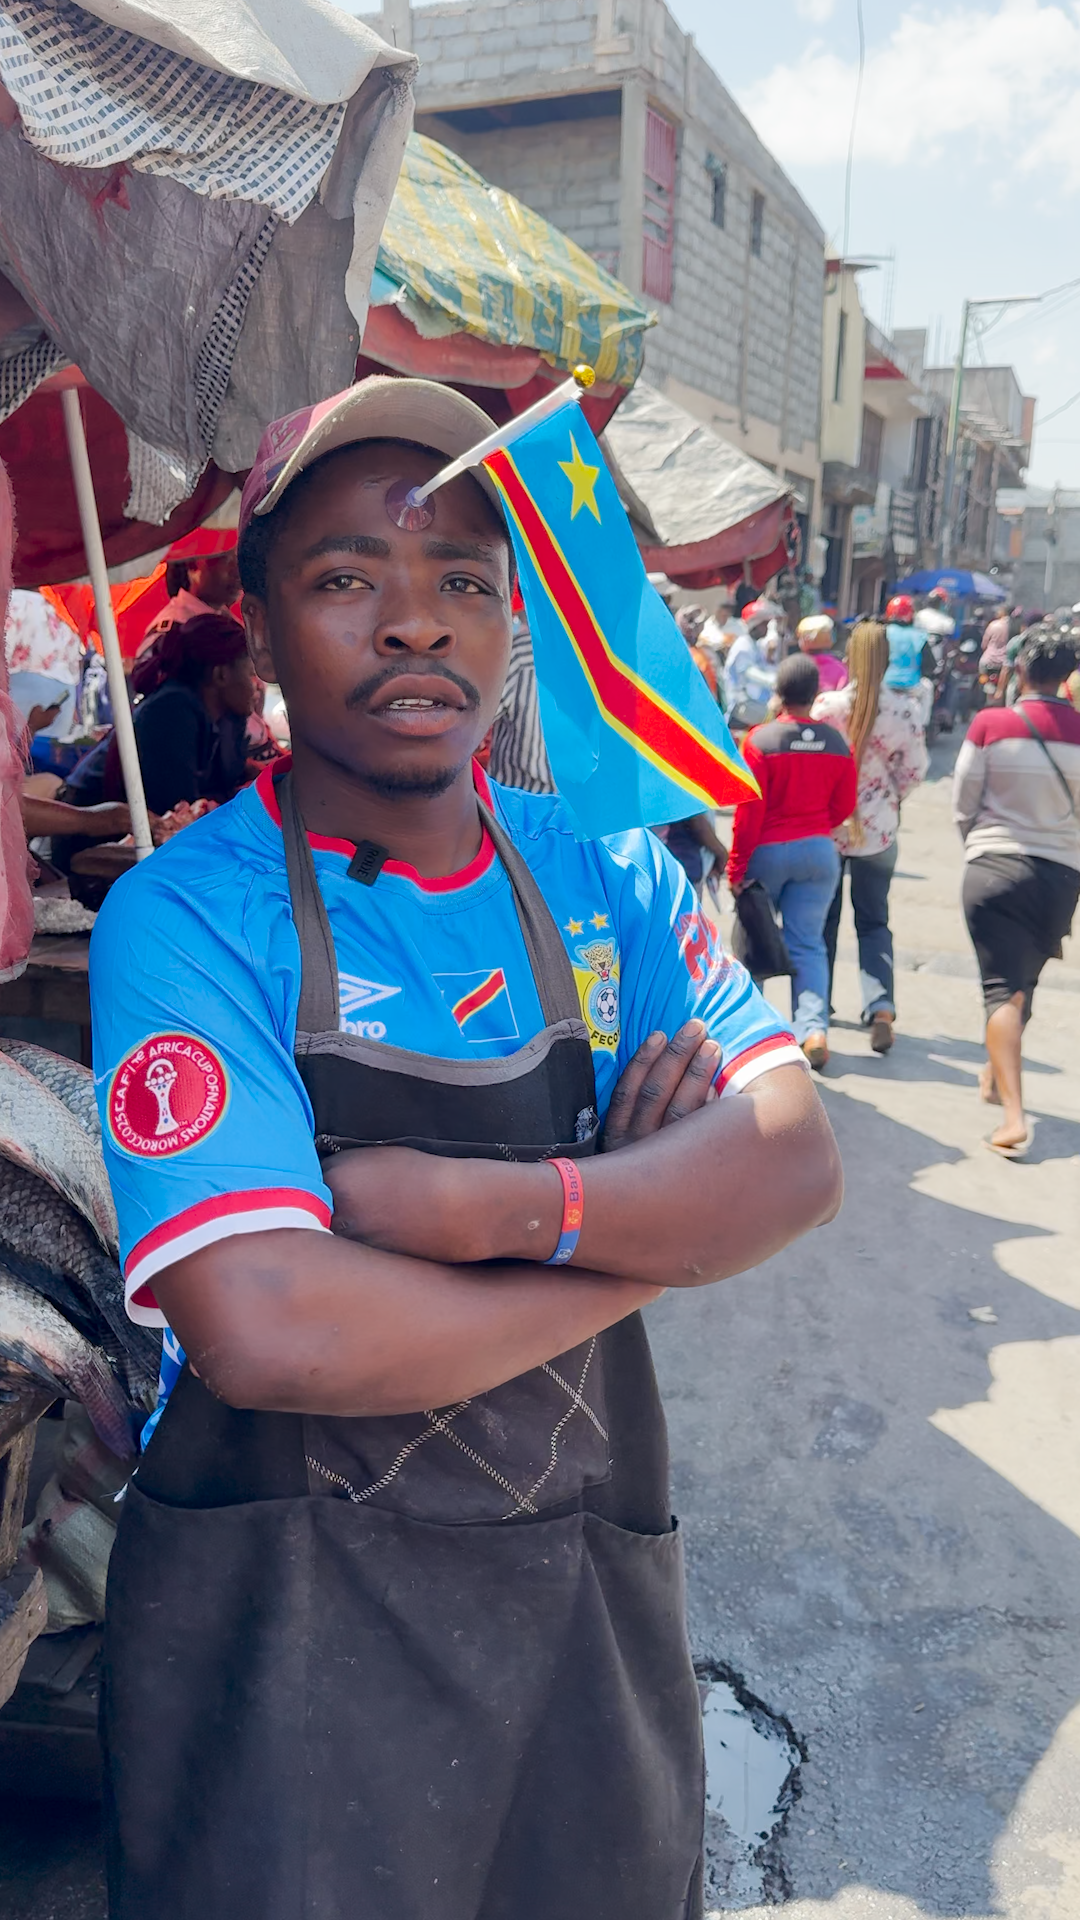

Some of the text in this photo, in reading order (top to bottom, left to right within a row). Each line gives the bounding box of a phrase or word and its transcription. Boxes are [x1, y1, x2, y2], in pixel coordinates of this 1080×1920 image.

[149, 1041, 192, 1058] AFRICA
[191, 1050, 214, 1073] CUP
[114, 1073, 131, 1113] CAF
[206, 1074, 219, 1093] OF
[180, 1091, 219, 1142] NATIONS
